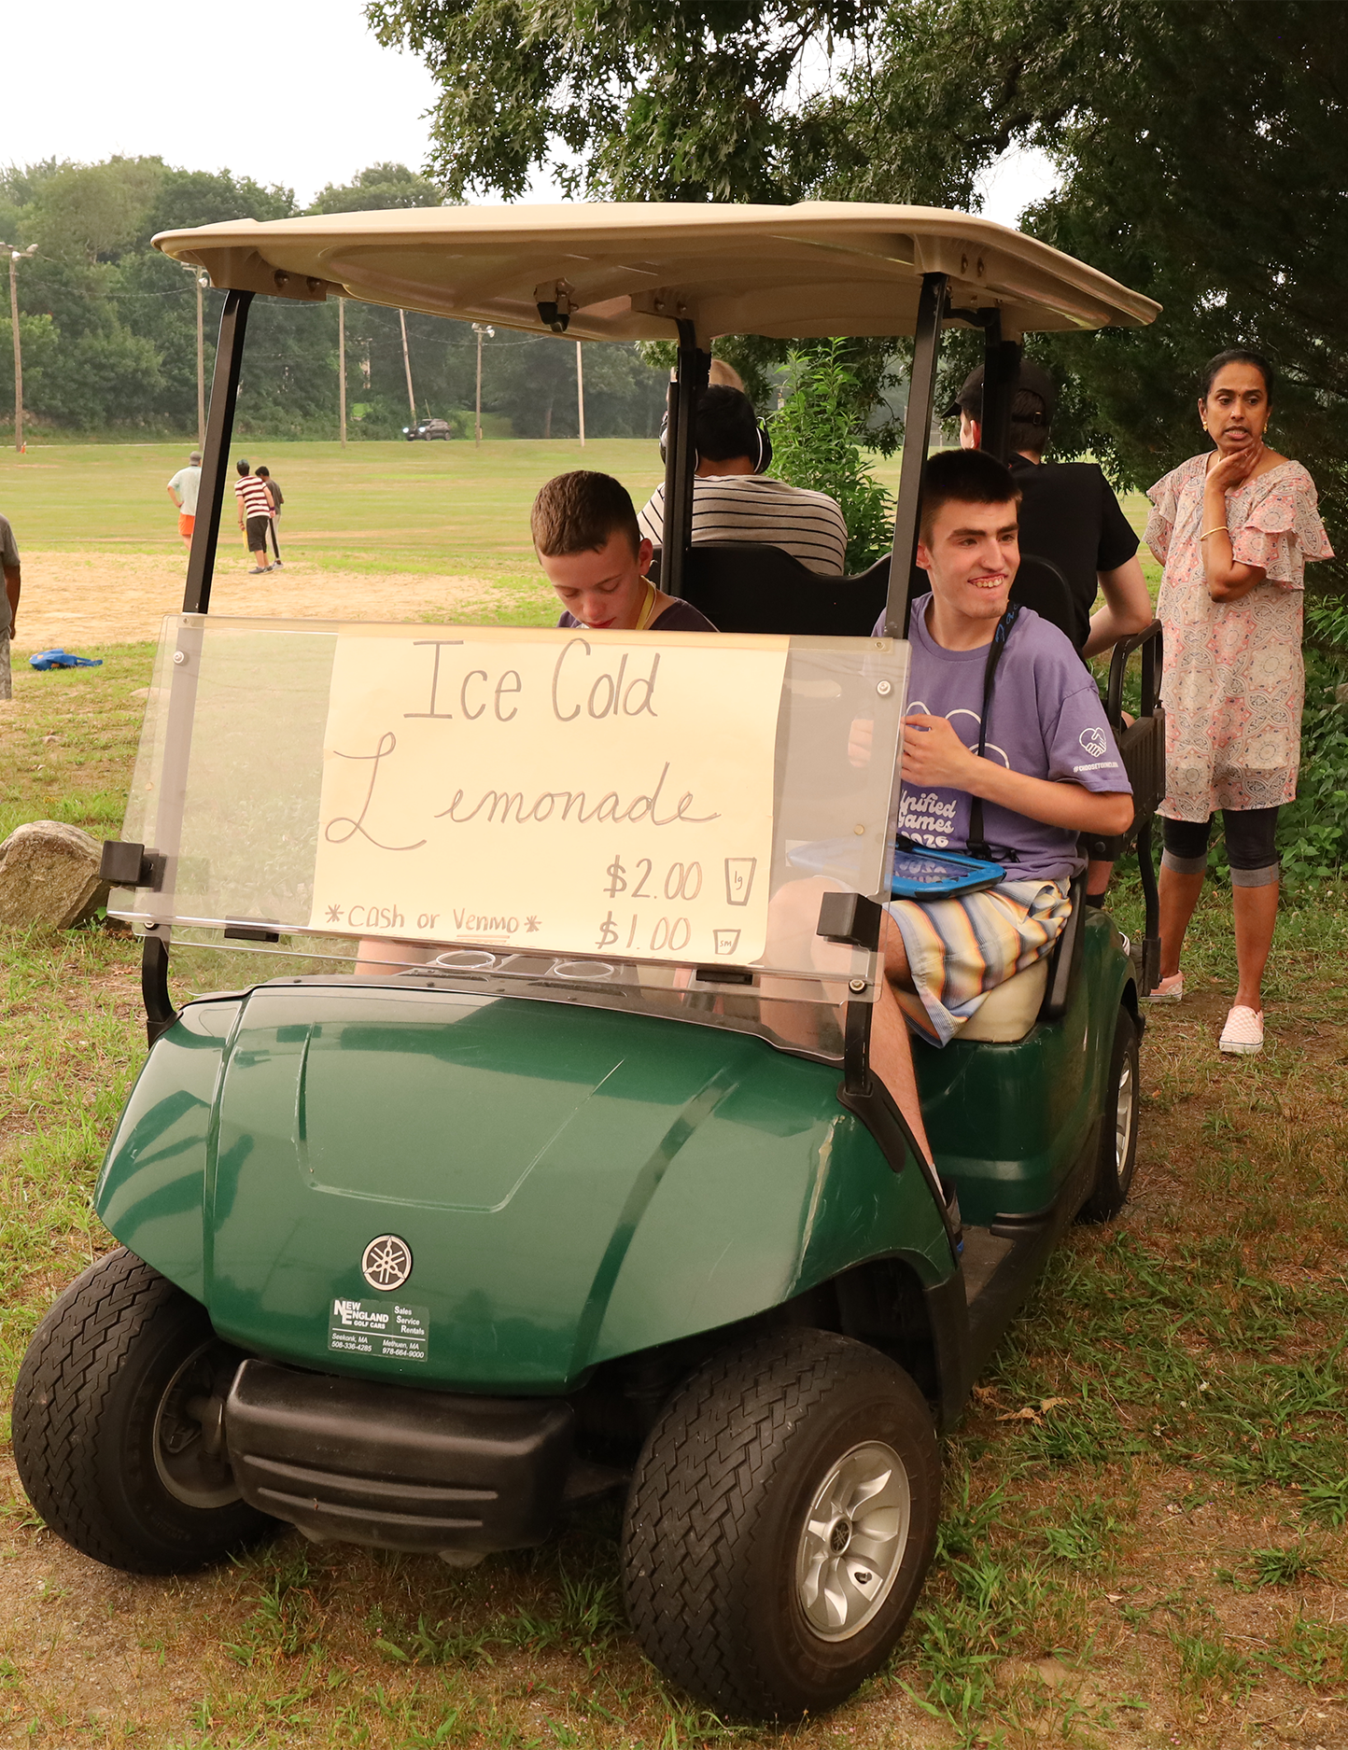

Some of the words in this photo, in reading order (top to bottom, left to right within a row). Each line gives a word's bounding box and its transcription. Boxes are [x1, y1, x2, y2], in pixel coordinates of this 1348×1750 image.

[403, 640, 522, 722] Ice
[552, 638, 661, 722] Cold
[325, 732, 721, 850] Lemonade
[603, 854, 703, 900] $2.00
[417, 913, 440, 929] or
[594, 910, 691, 951] $1.00
[334, 1300, 361, 1316] NEW
[394, 1305, 412, 1315] Sales
[341, 1310, 389, 1325] ENGLAND
[353, 1320, 369, 1328] GOLF
[396, 1315, 420, 1325] Service
[401, 1325, 424, 1335] Rentals
[358, 1336, 368, 1344] MA
